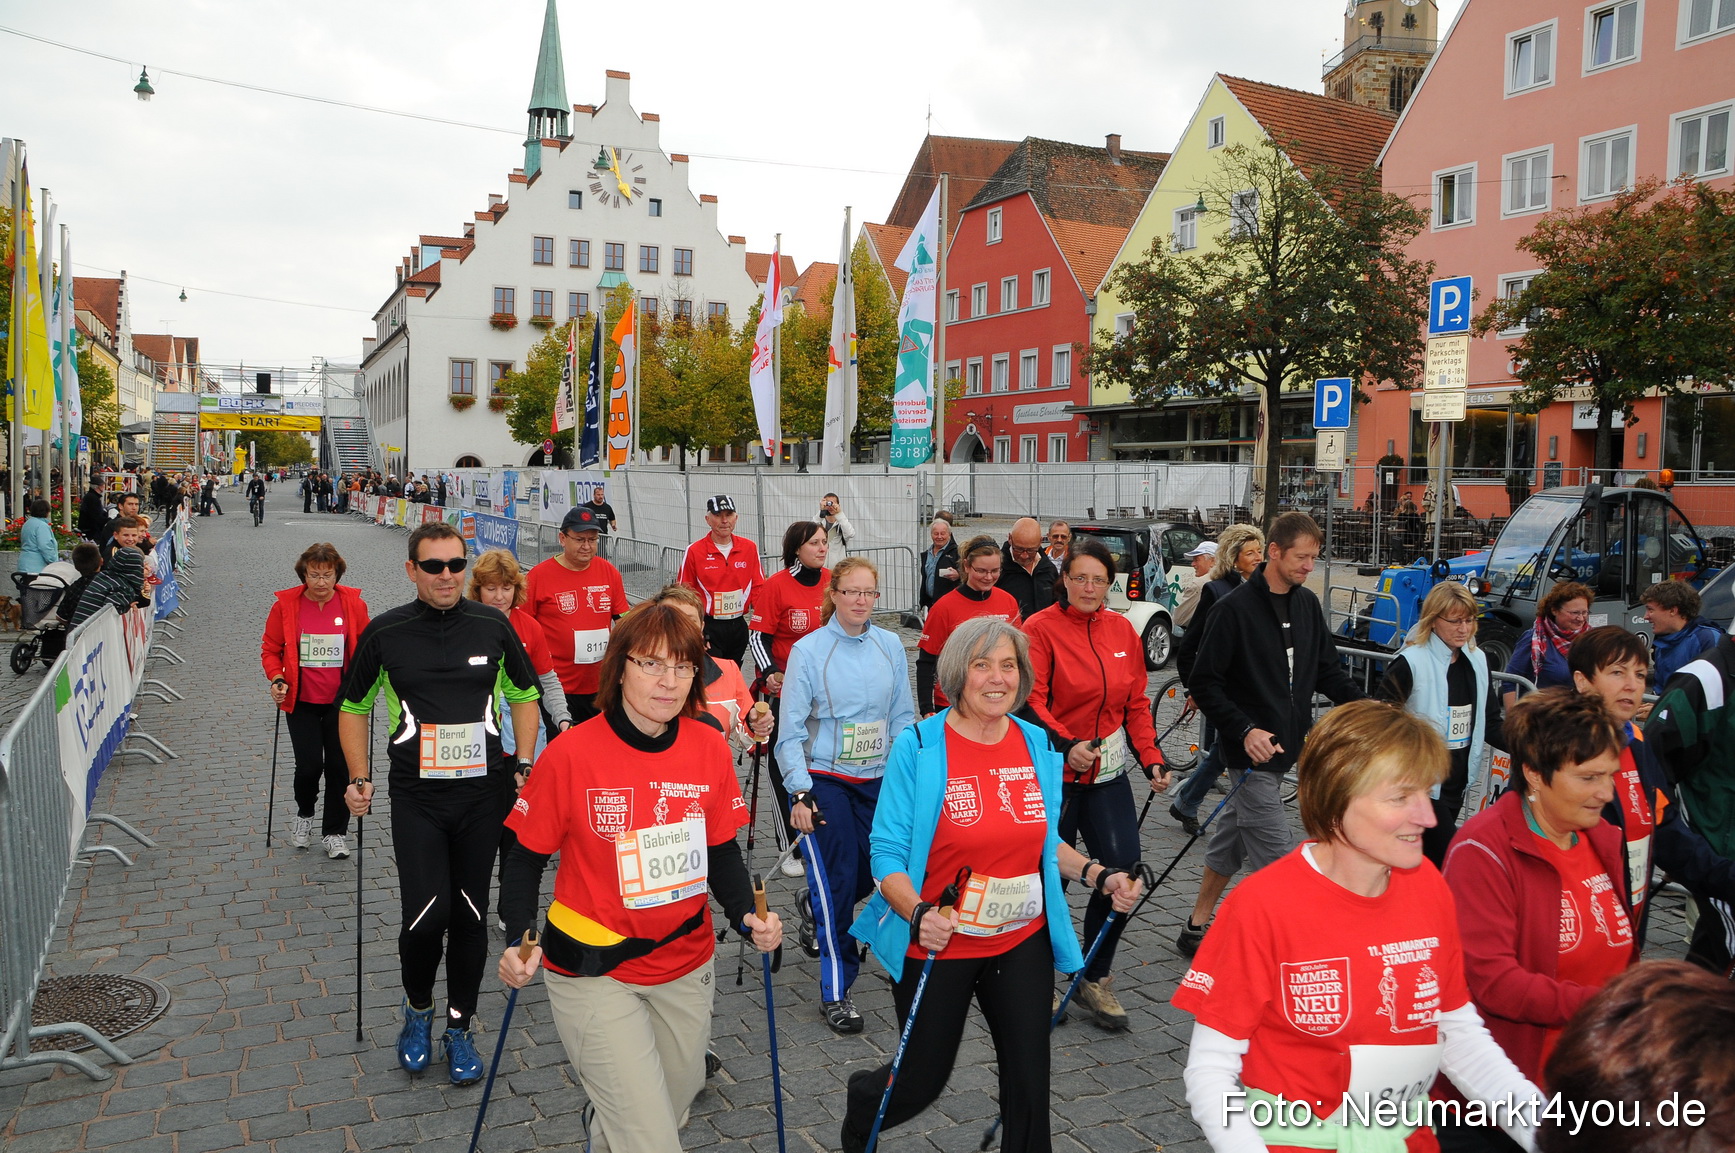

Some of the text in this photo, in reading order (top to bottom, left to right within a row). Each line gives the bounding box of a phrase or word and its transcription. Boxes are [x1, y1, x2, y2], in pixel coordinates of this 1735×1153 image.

[1438, 285, 1461, 327] P
[1449, 339, 1460, 347] mit
[1430, 348, 1465, 357] Parkschein
[1432, 358, 1462, 366] werktags
[1322, 385, 1343, 422] P
[240, 417, 282, 426] START
[724, 601, 742, 610] 8014
[312, 647, 340, 656] 8053
[586, 641, 608, 653] 8117
[440, 728, 466, 739] Bernd
[857, 726, 879, 736] Sabrina
[1452, 722, 1471, 735] 801
[441, 743, 482, 760] 8052
[856, 738, 883, 753] 8043
[999, 773, 1035, 782] STADTLAUF
[649, 781, 710, 792] 11. NEUMARKTER
[594, 795, 626, 804] IMMER
[660, 789, 701, 799] STADTLAUF
[945, 791, 976, 802] WIEDER
[593, 804, 628, 813] WIEDER
[948, 799, 976, 811] NEU
[596, 813, 626, 825] NEU
[951, 810, 978, 819] MARKT
[596, 825, 627, 833] MARKT
[642, 828, 690, 850] Gabriele
[648, 849, 701, 880] 8020
[986, 900, 1037, 919] 8046
[1367, 936, 1440, 957] 11. NEUMARKTER
[1382, 949, 1433, 966] STADTLAUF
[1289, 969, 1340, 984] IMMER
[1288, 981, 1344, 996] WIEDER
[1293, 994, 1341, 1013] NEU
[1294, 1013, 1342, 1025] MARKT
